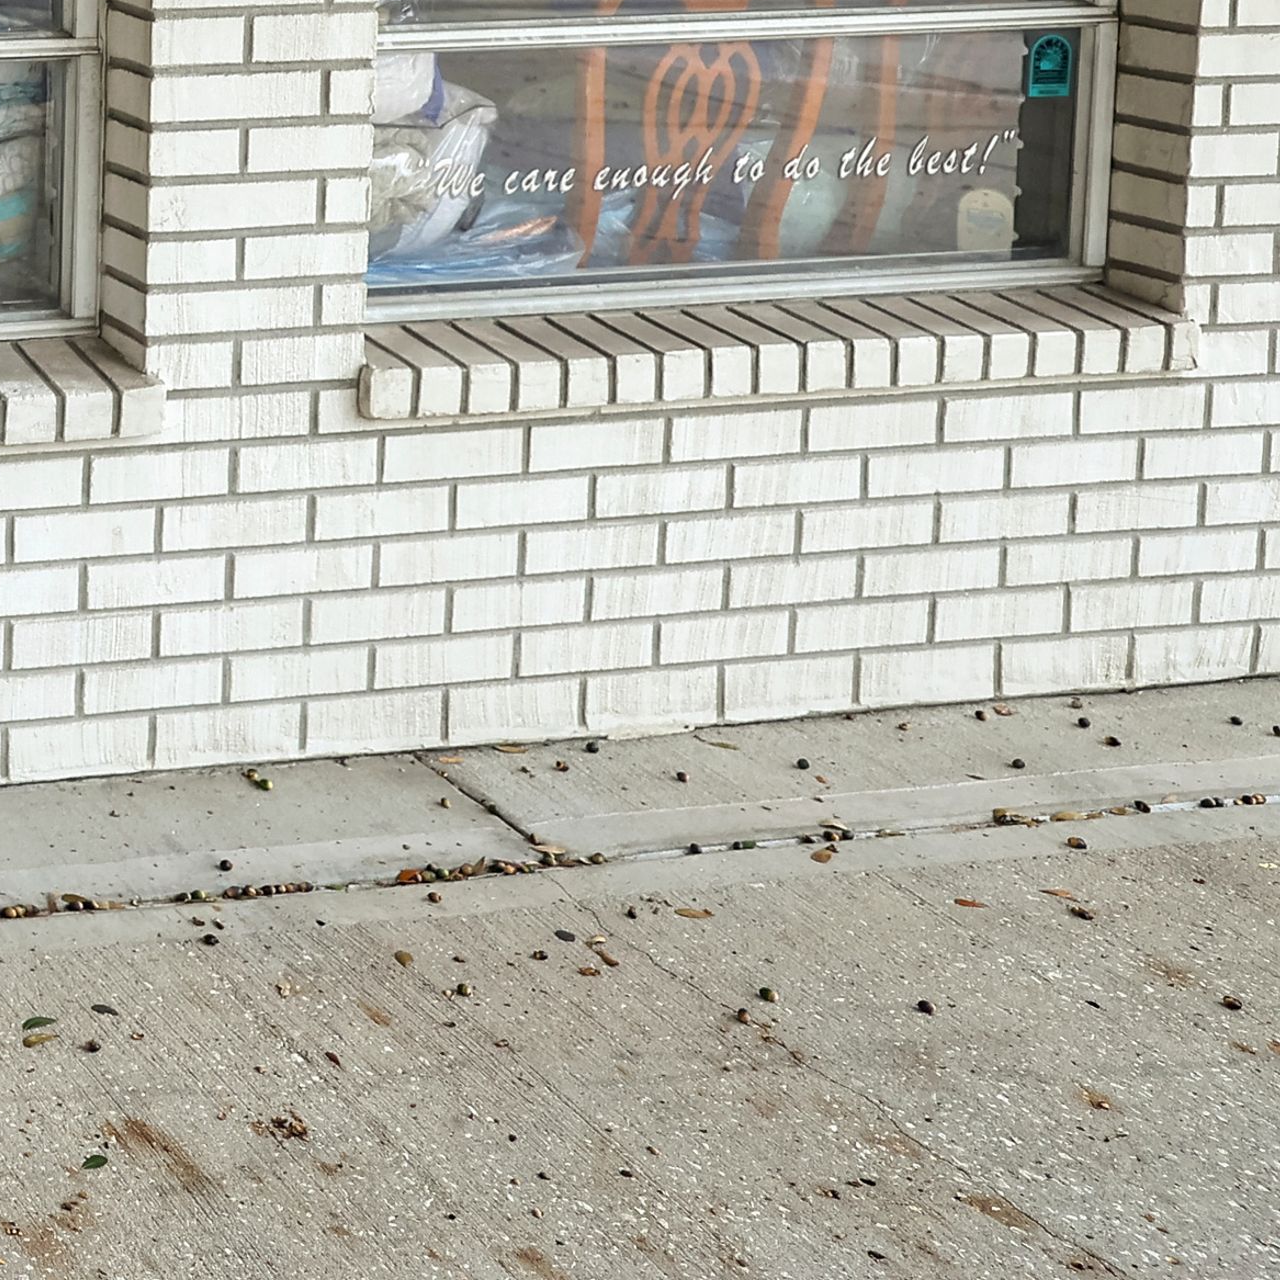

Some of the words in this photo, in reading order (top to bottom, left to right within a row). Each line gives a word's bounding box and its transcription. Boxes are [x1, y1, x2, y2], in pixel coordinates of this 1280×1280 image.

[503, 167, 577, 195] care
[593, 147, 713, 200] enough
[733, 151, 766, 184] to
[783, 134, 820, 179] do
[839, 127, 891, 179] the
